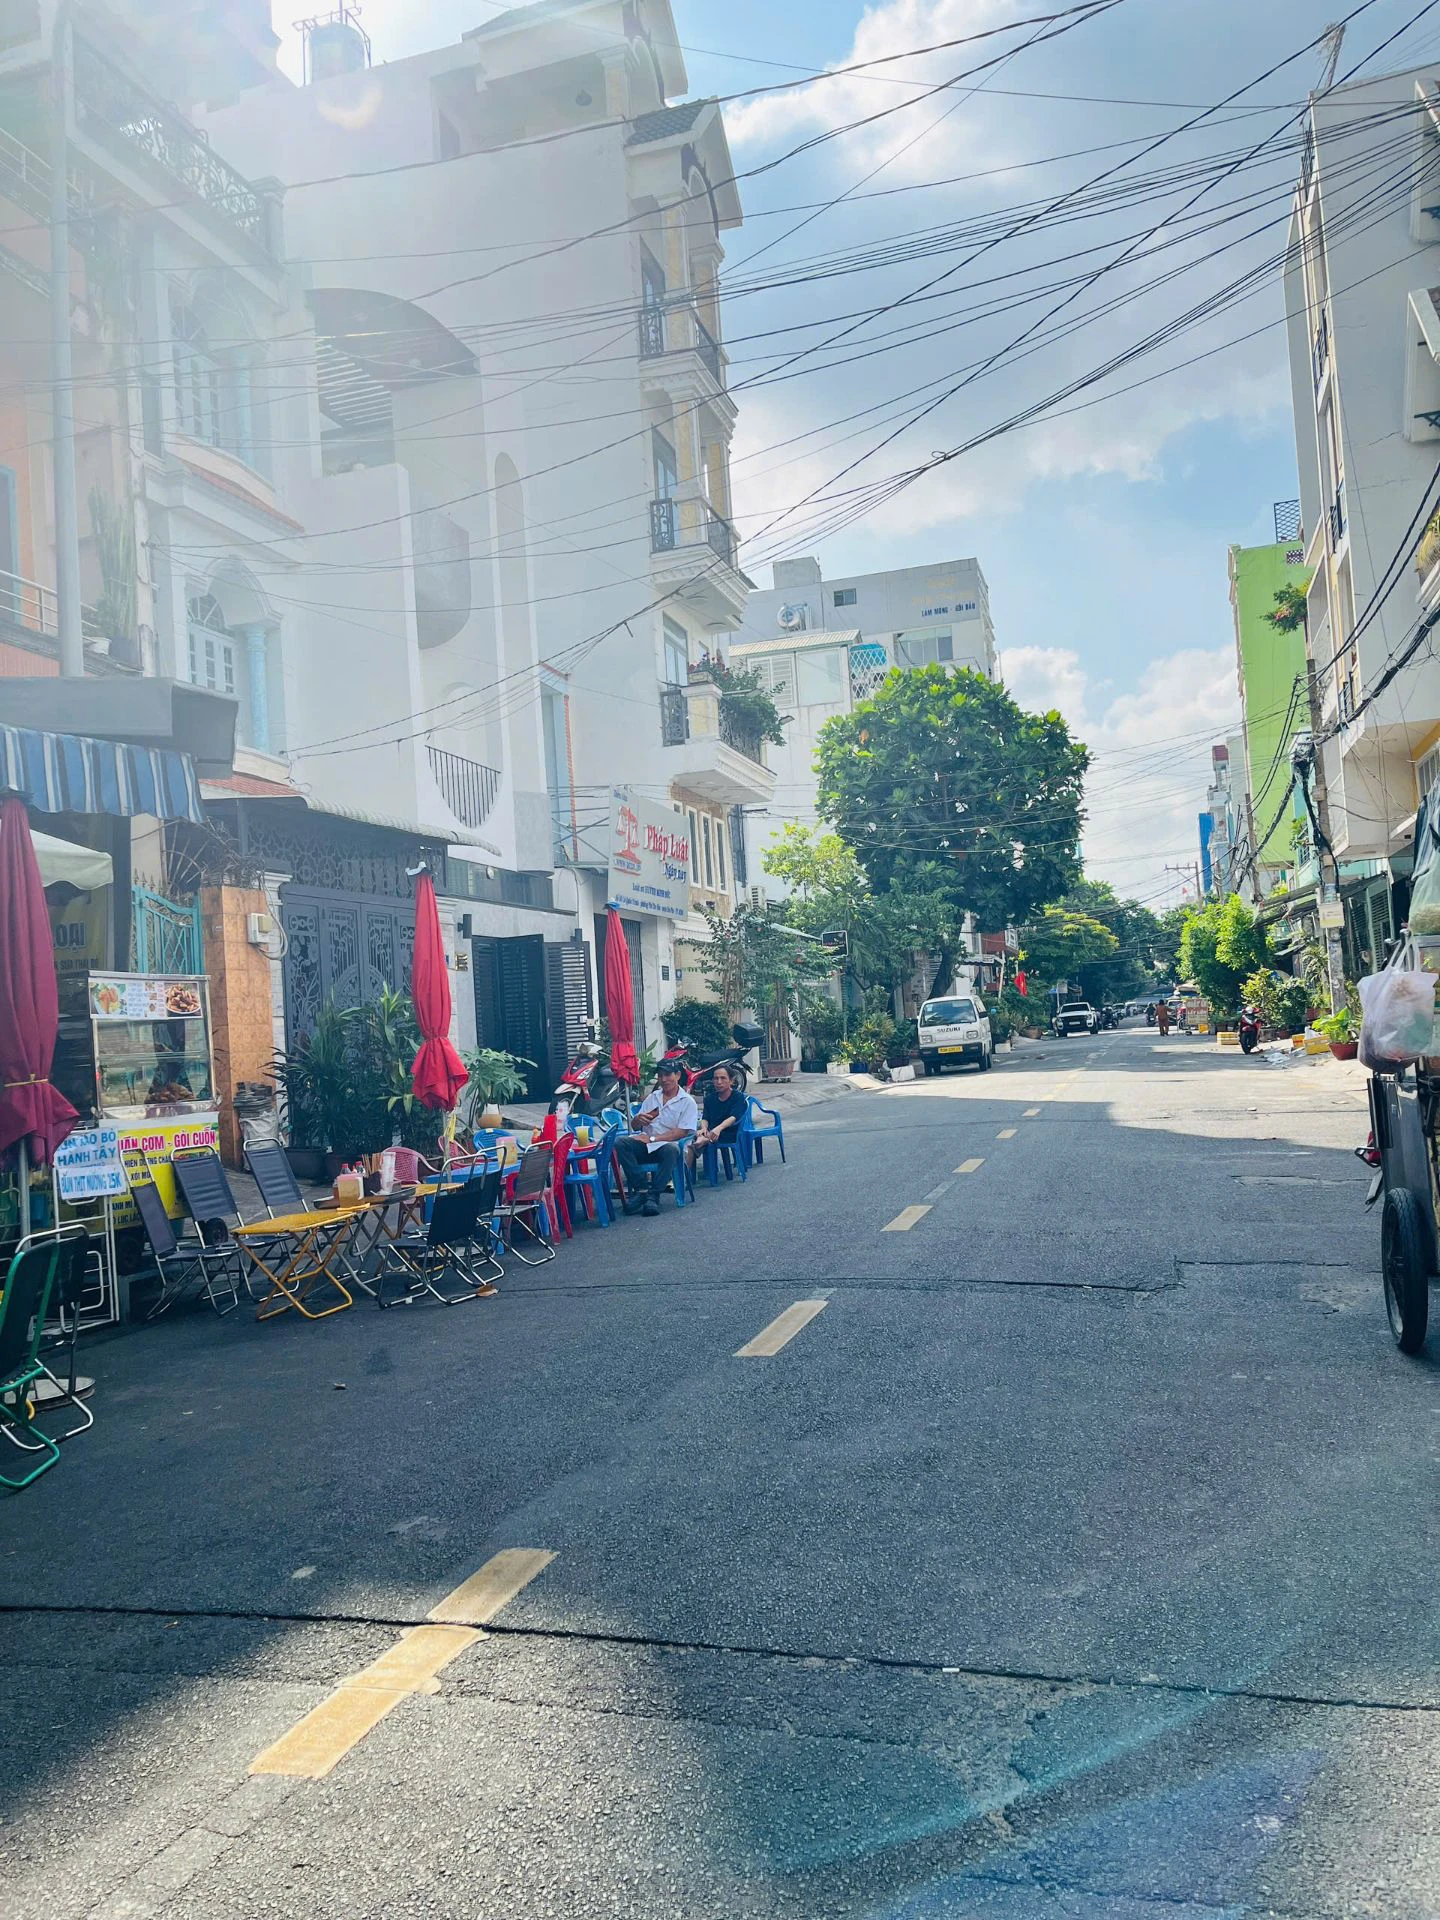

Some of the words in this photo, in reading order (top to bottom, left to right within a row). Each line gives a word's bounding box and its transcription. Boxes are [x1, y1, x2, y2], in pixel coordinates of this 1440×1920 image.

[643, 824, 668, 862] Pháp
[53, 920, 86, 953] OẠI
[57, 1150, 90, 1167] HÀNH
